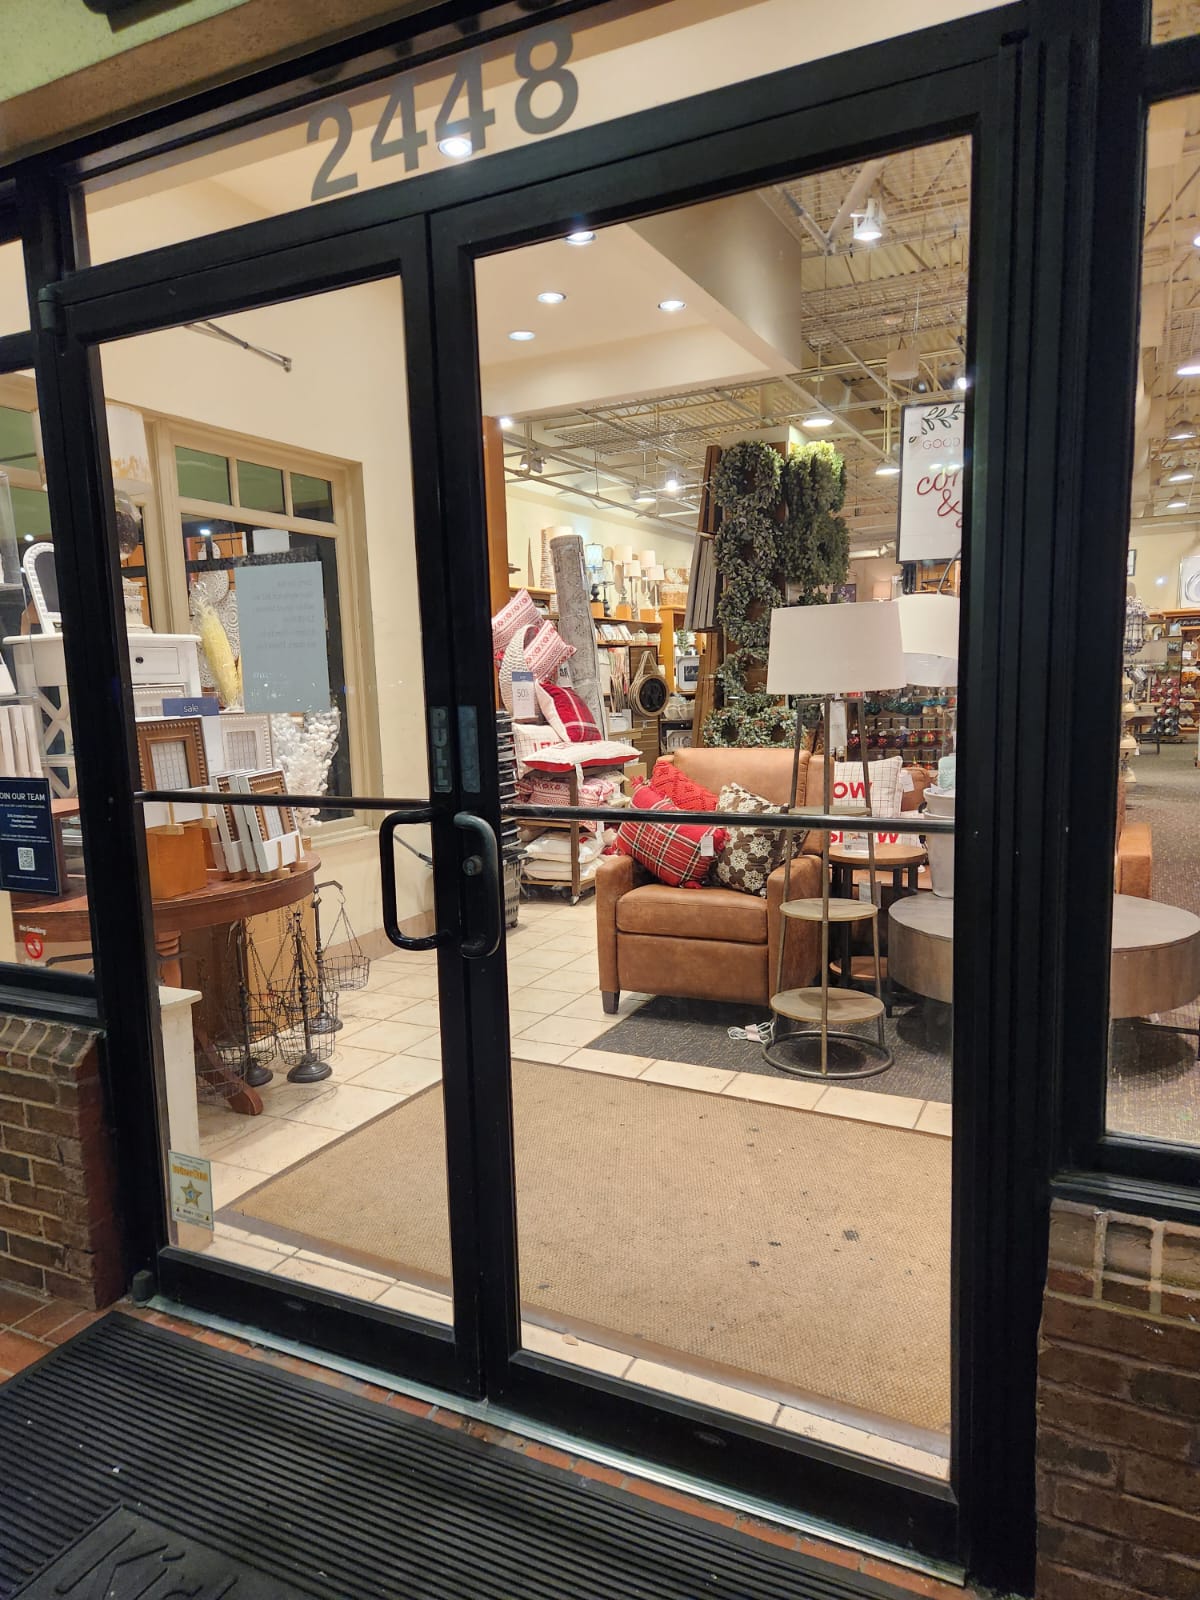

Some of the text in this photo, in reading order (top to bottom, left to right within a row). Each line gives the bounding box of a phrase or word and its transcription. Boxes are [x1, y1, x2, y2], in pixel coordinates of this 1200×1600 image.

[306, 22, 578, 201] 2448
[183, 703, 199, 713] sale
[431, 708, 449, 785] PULL
[0, 792, 46, 801] OIN OUR TEAM
[832, 781, 873, 799] OW
